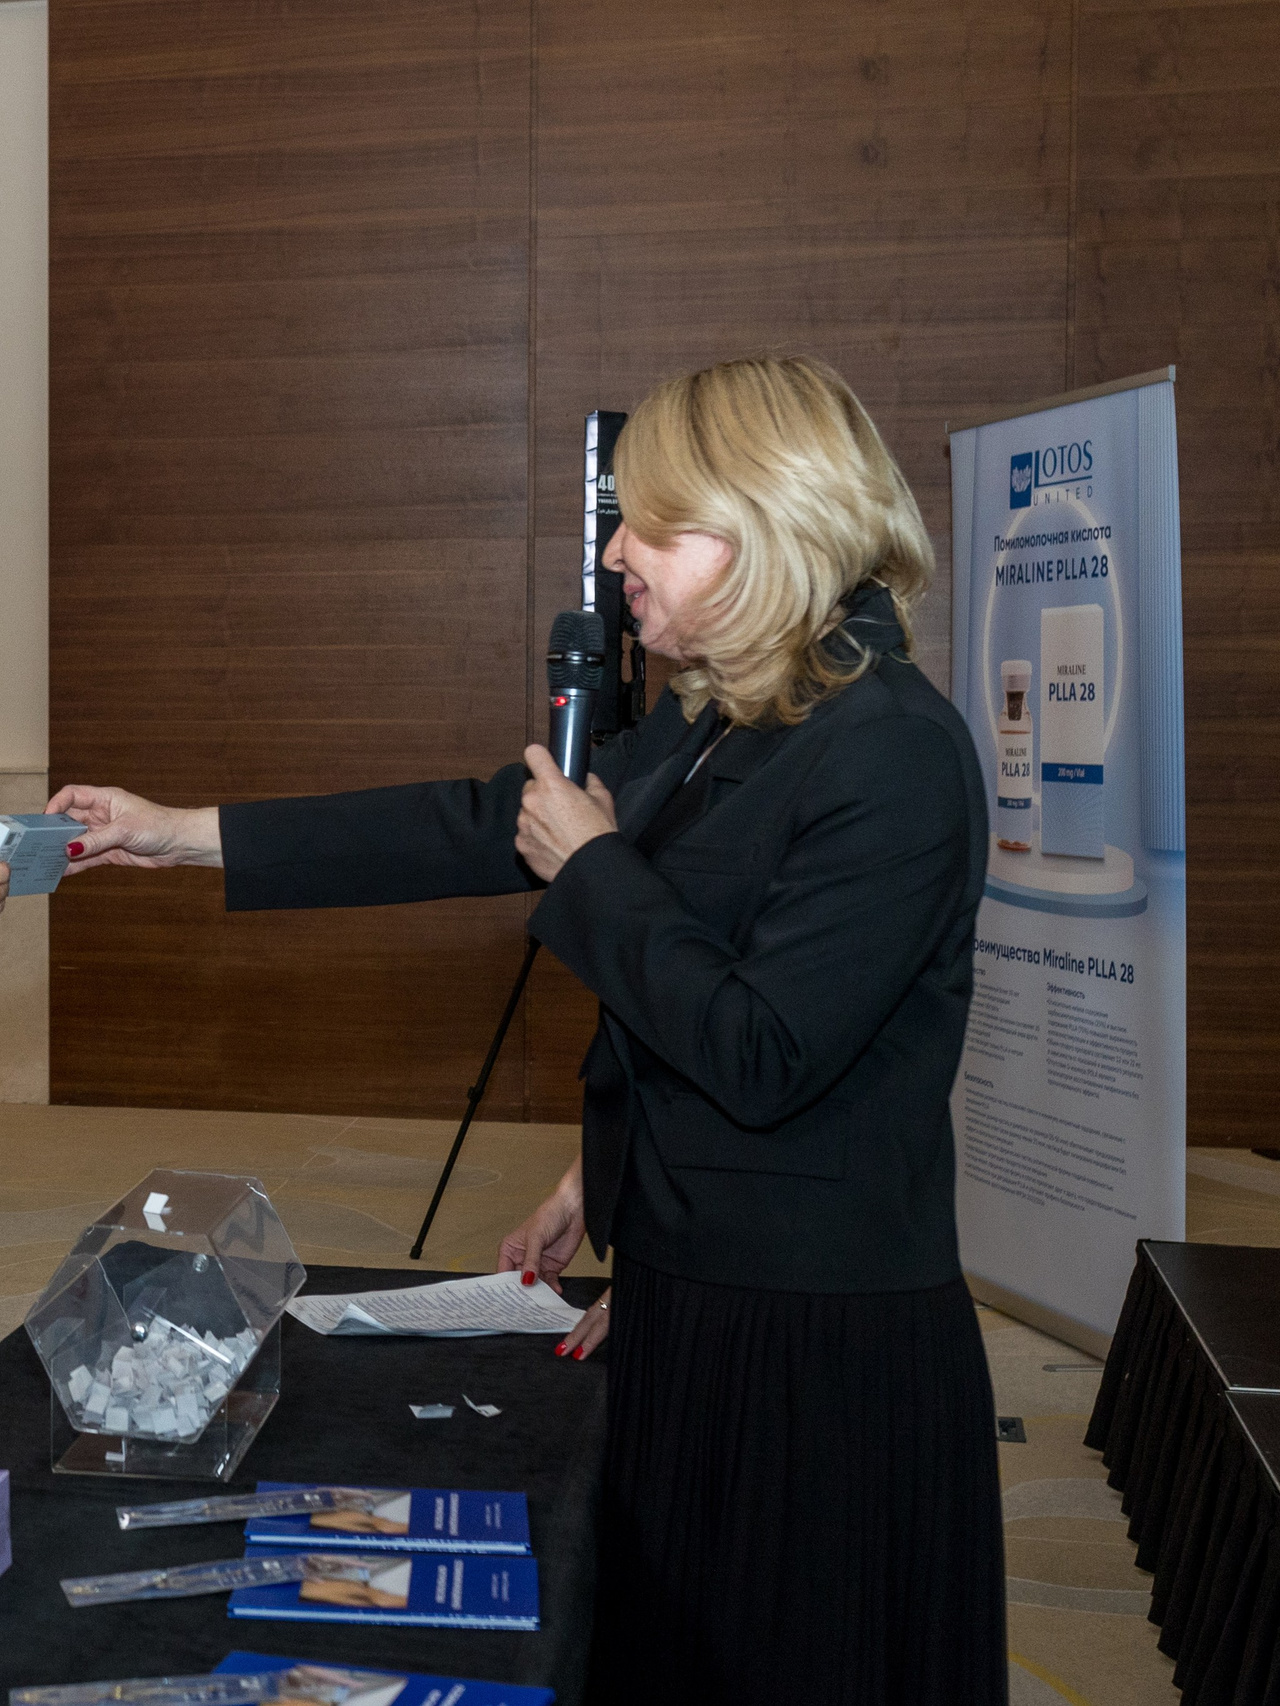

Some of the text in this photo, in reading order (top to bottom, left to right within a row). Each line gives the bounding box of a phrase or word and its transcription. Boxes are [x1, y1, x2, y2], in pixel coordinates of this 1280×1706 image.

[1034, 440, 1093, 488] LOTOS
[1033, 486, 1093, 506] UNITED
[1071, 525, 1111, 542] кислота
[995, 555, 1109, 586] MIRALINE PLLA 28
[1057, 664, 1086, 676] MIRALINE
[1049, 682, 1095, 702] PLLA 28
[1001, 762, 1030, 777] PLLA 28
[973, 938, 1135, 984] реимущества Miraline PLLA 28
